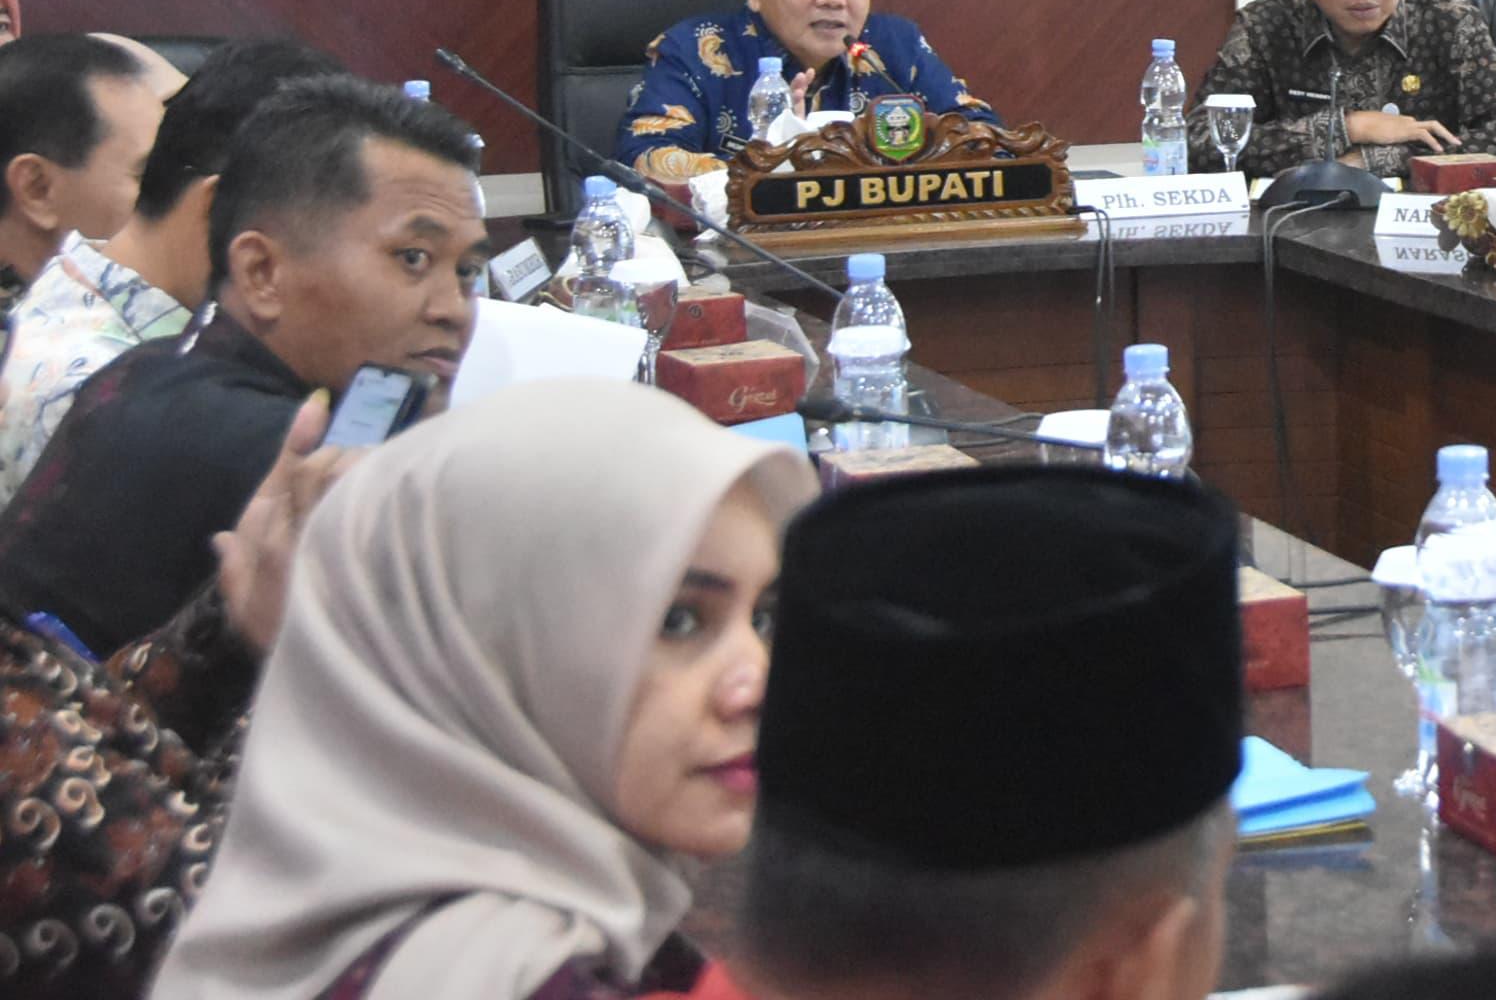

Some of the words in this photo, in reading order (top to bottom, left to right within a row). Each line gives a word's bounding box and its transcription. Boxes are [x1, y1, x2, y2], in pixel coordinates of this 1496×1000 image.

[796, 179, 845, 209] PJ
[860, 170, 1004, 205] BUPATI
[1102, 193, 1145, 210] Plh.
[1153, 188, 1233, 207] SEKDA
